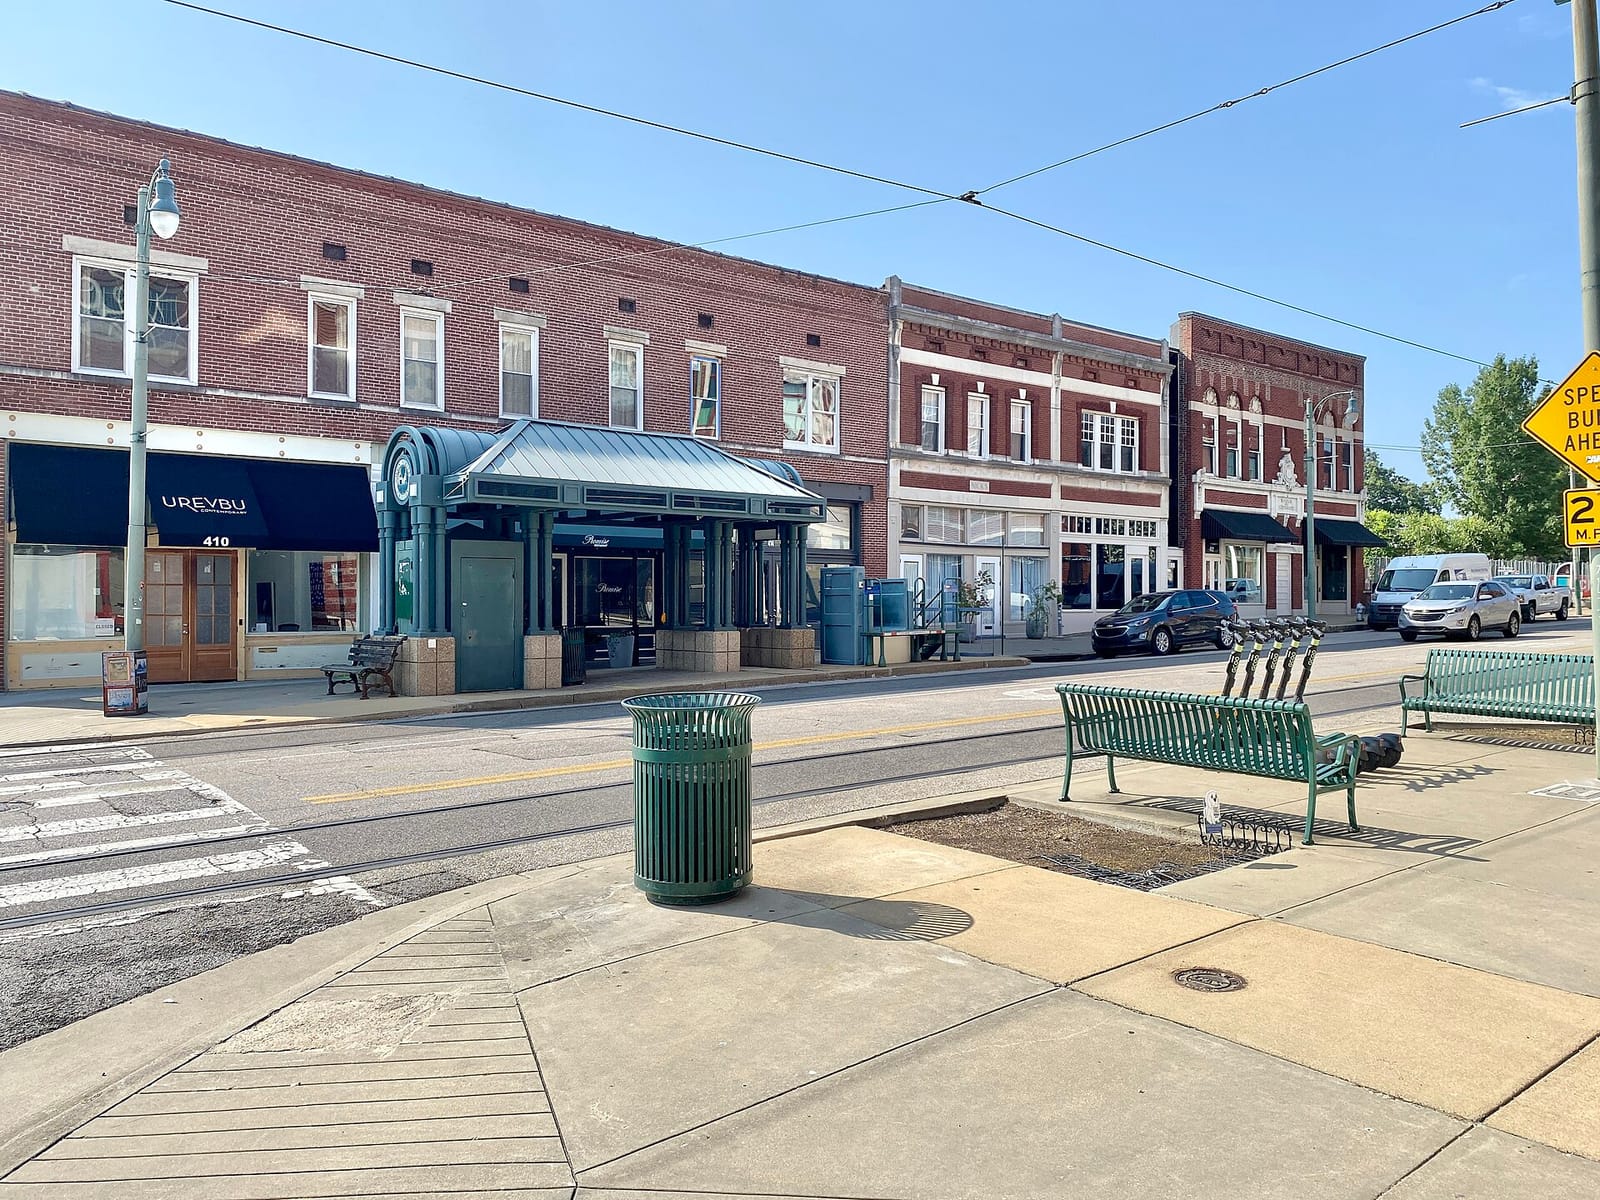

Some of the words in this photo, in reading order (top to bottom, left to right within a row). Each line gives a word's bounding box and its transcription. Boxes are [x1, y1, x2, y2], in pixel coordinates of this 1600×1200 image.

[1568, 409, 1600, 429] BU
[161, 495, 246, 513] UREVBU
[202, 536, 230, 547] 410
